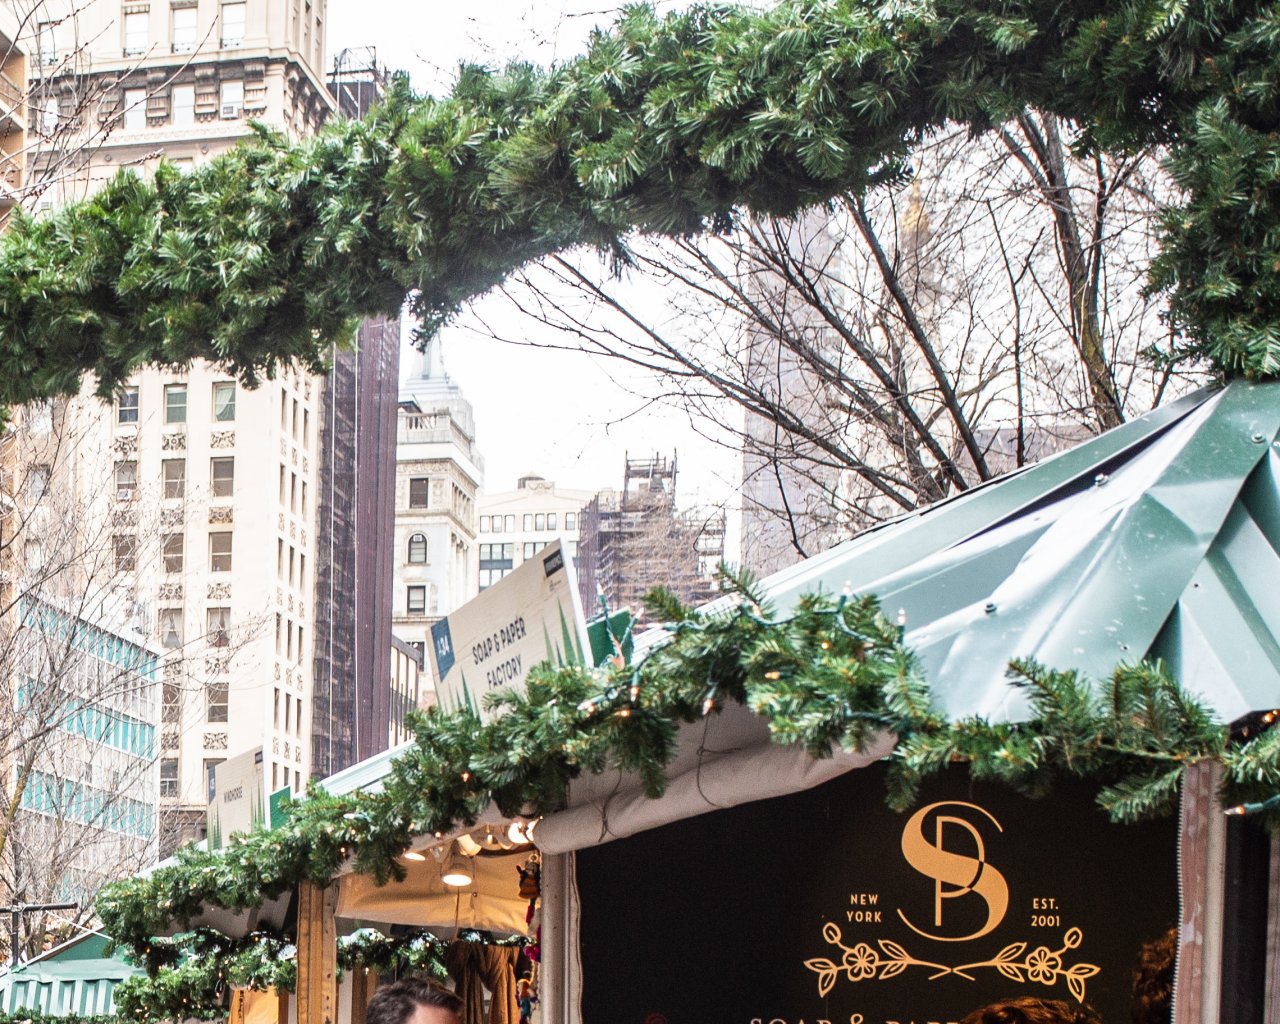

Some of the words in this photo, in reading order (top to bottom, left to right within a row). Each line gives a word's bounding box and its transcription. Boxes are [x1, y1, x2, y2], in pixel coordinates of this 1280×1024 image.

[472, 635, 493, 665] SOAP
[494, 633, 500, 652] &
[500, 616, 527, 648] PAPER
[486, 654, 522, 690] FACTORY
[851, 894, 879, 905] NEW
[1032, 898, 1059, 910] EST.
[846, 911, 882, 923] YORK
[1031, 915, 1060, 927] 2001
